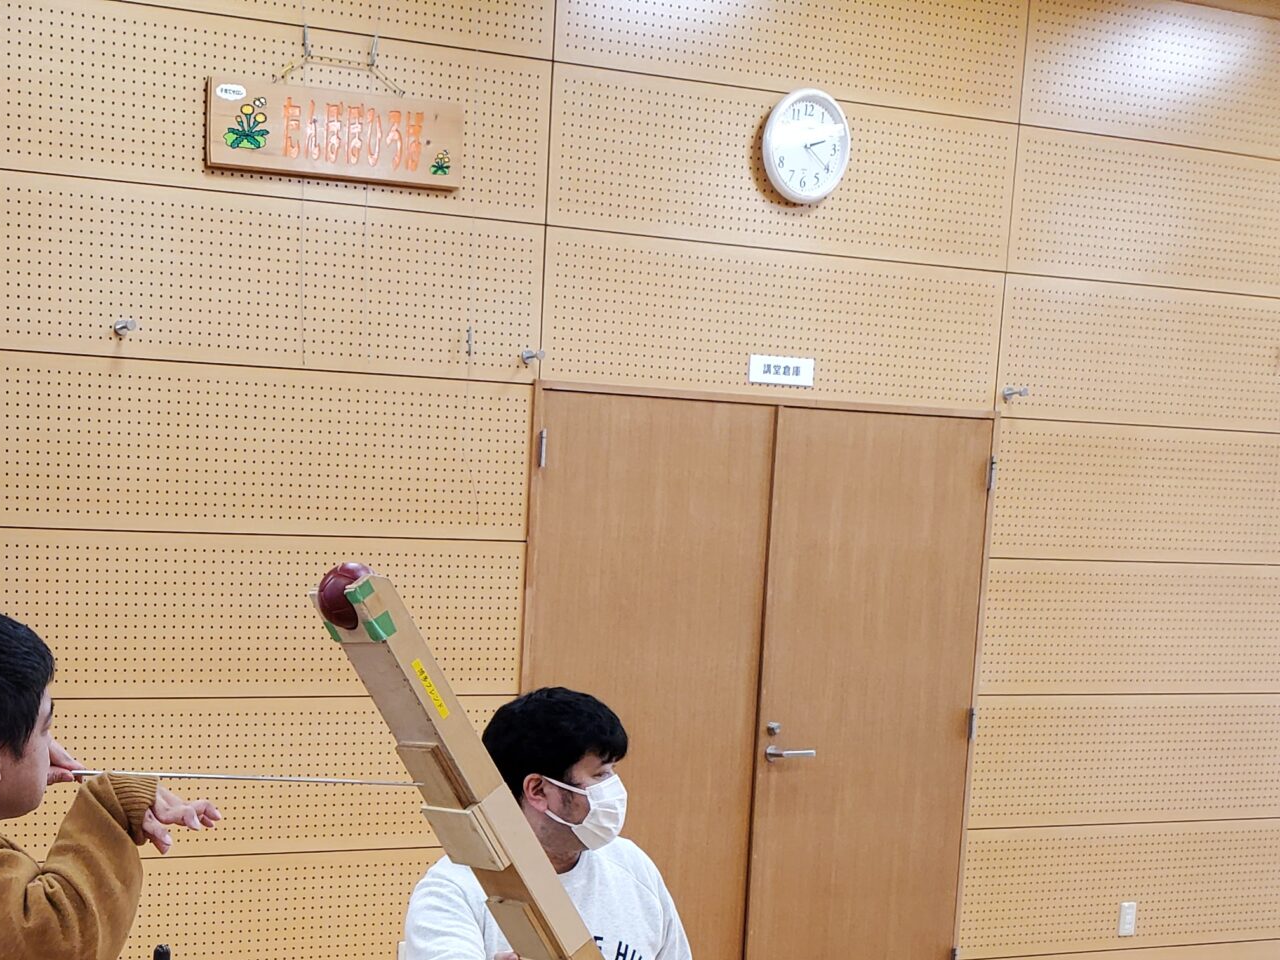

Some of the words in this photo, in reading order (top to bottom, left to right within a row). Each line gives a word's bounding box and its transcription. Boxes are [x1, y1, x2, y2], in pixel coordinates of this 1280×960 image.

[804, 104, 815, 117] 12
[282, 96, 425, 172] たんぽぽひろば
[830, 143, 837, 157] 3
[763, 363, 801, 377] 講堂倉庫
